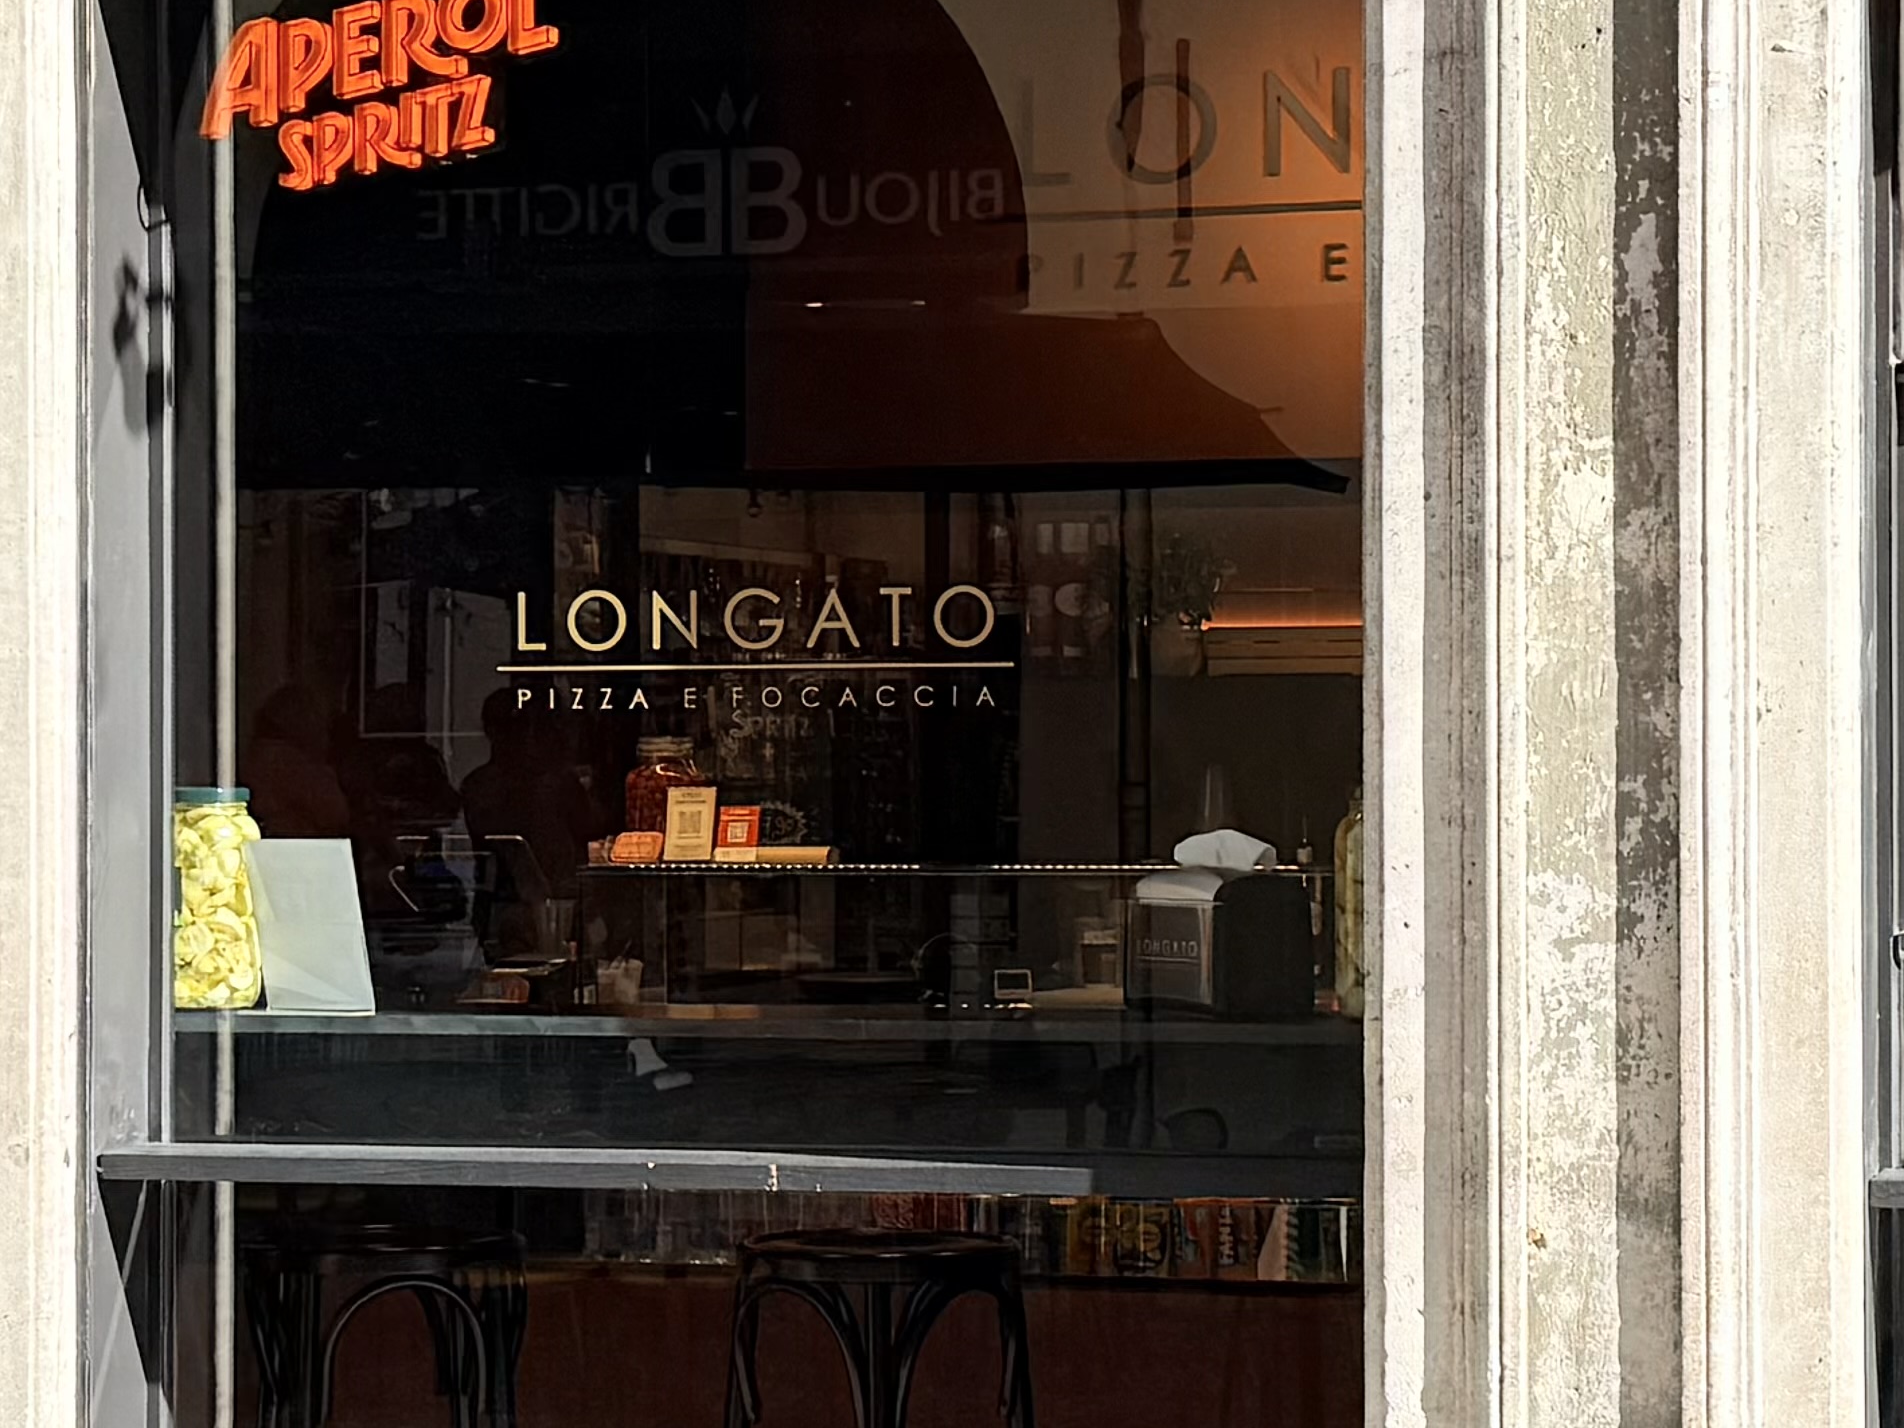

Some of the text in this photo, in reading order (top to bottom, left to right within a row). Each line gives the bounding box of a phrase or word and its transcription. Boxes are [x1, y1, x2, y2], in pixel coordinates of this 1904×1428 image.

[277, 74, 496, 191] SPRITZ
[516, 584, 996, 652] LONGATO
[517, 685, 995, 710] PIZZA E FOCACCIA
